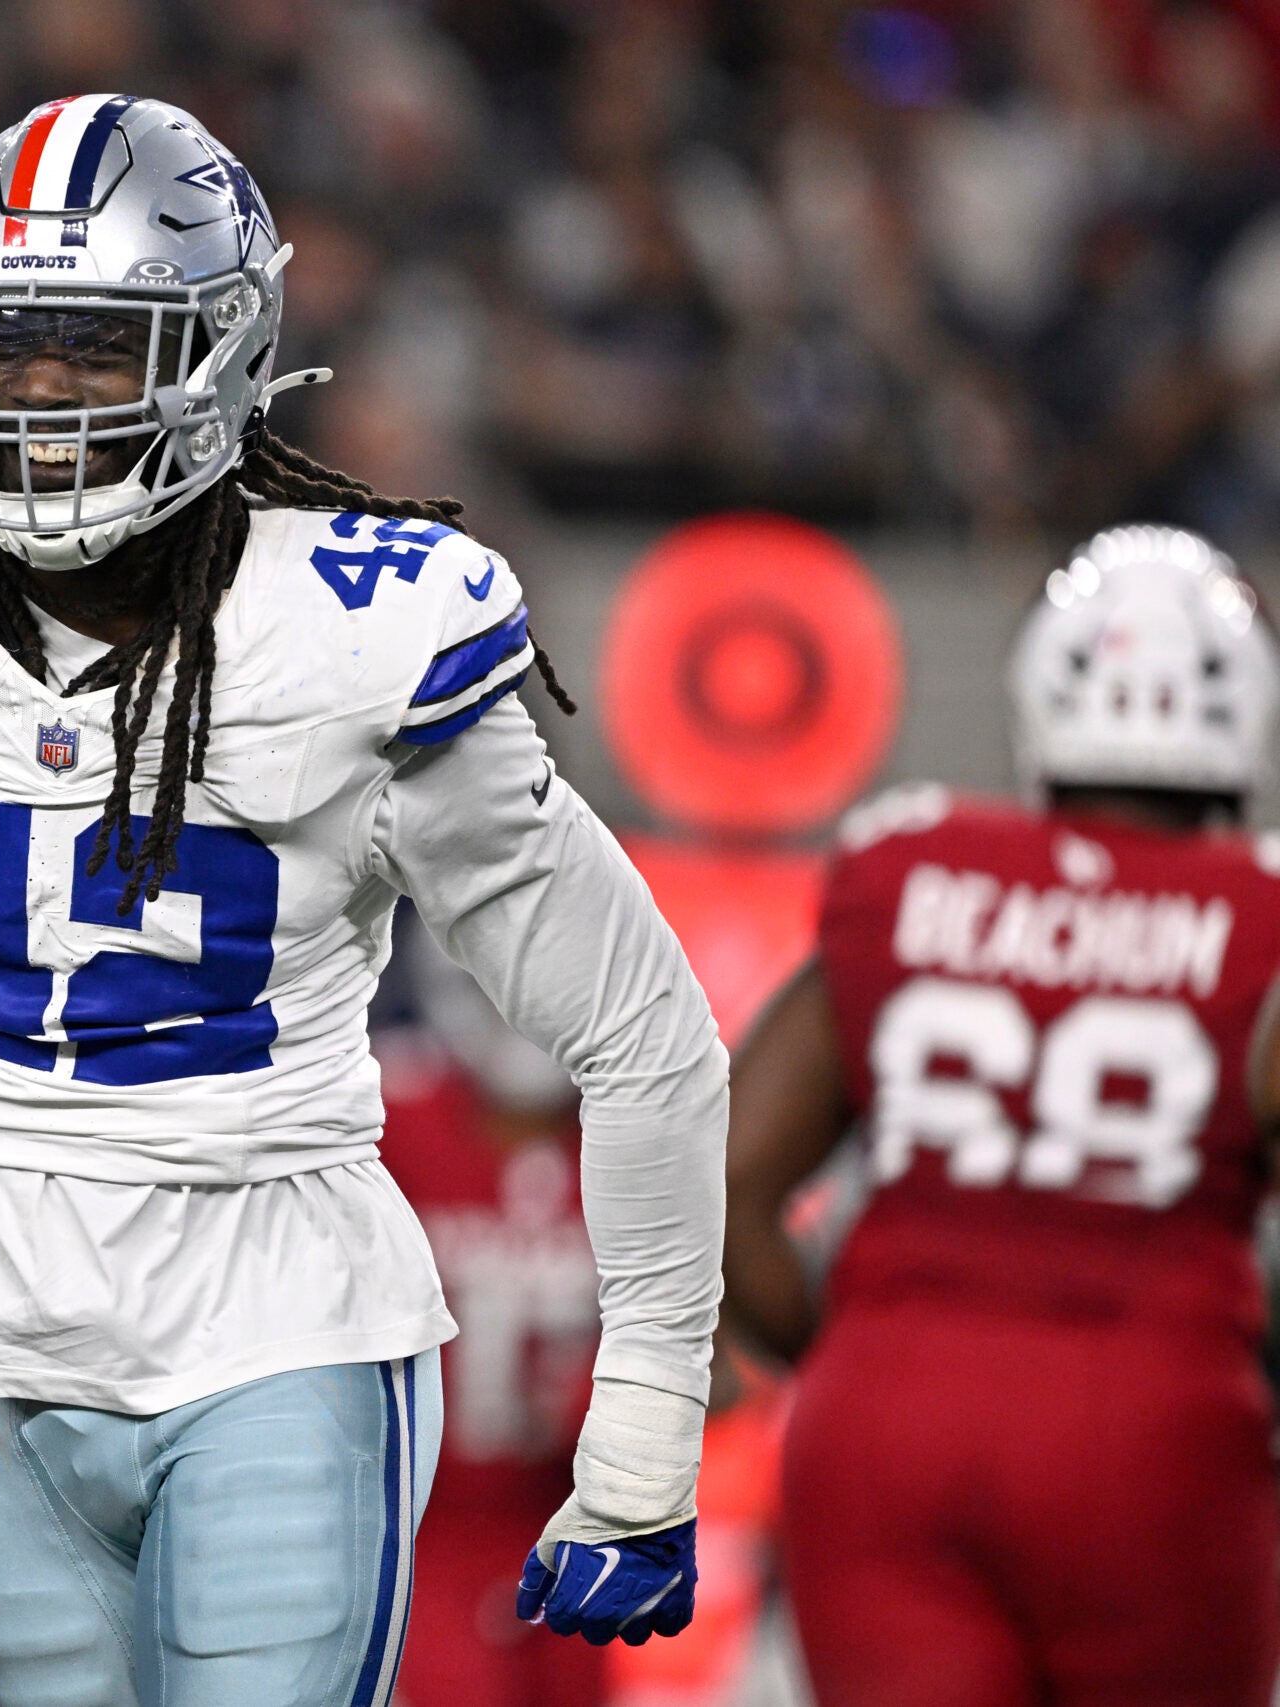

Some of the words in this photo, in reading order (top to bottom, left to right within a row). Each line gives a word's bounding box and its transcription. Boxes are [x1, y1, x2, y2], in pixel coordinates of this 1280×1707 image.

[1, 255, 77, 269] COWBOYS
[42, 743, 73, 767] NFL
[870, 972, 1218, 1208] 68
